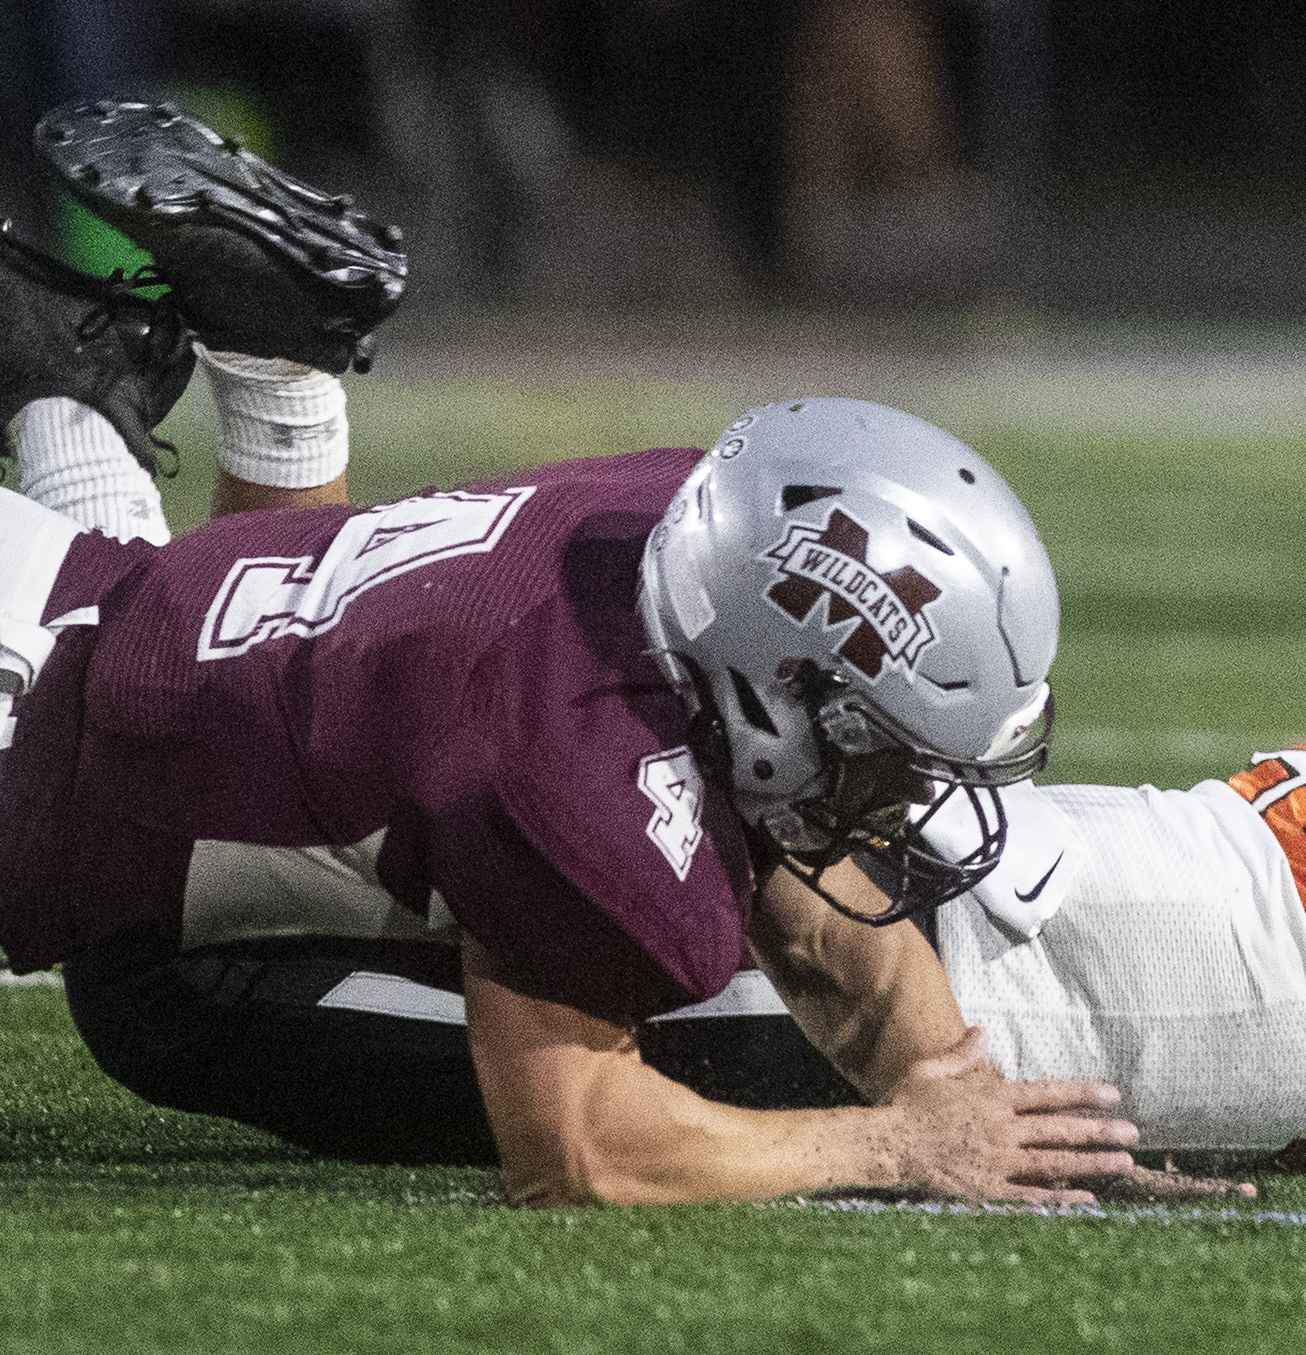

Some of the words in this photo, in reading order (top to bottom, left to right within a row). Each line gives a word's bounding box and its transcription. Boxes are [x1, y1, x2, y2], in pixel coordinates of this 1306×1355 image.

[196, 485, 537, 663] 4
[800, 548, 908, 644] WILDCATS
[637, 746, 703, 882] 4
